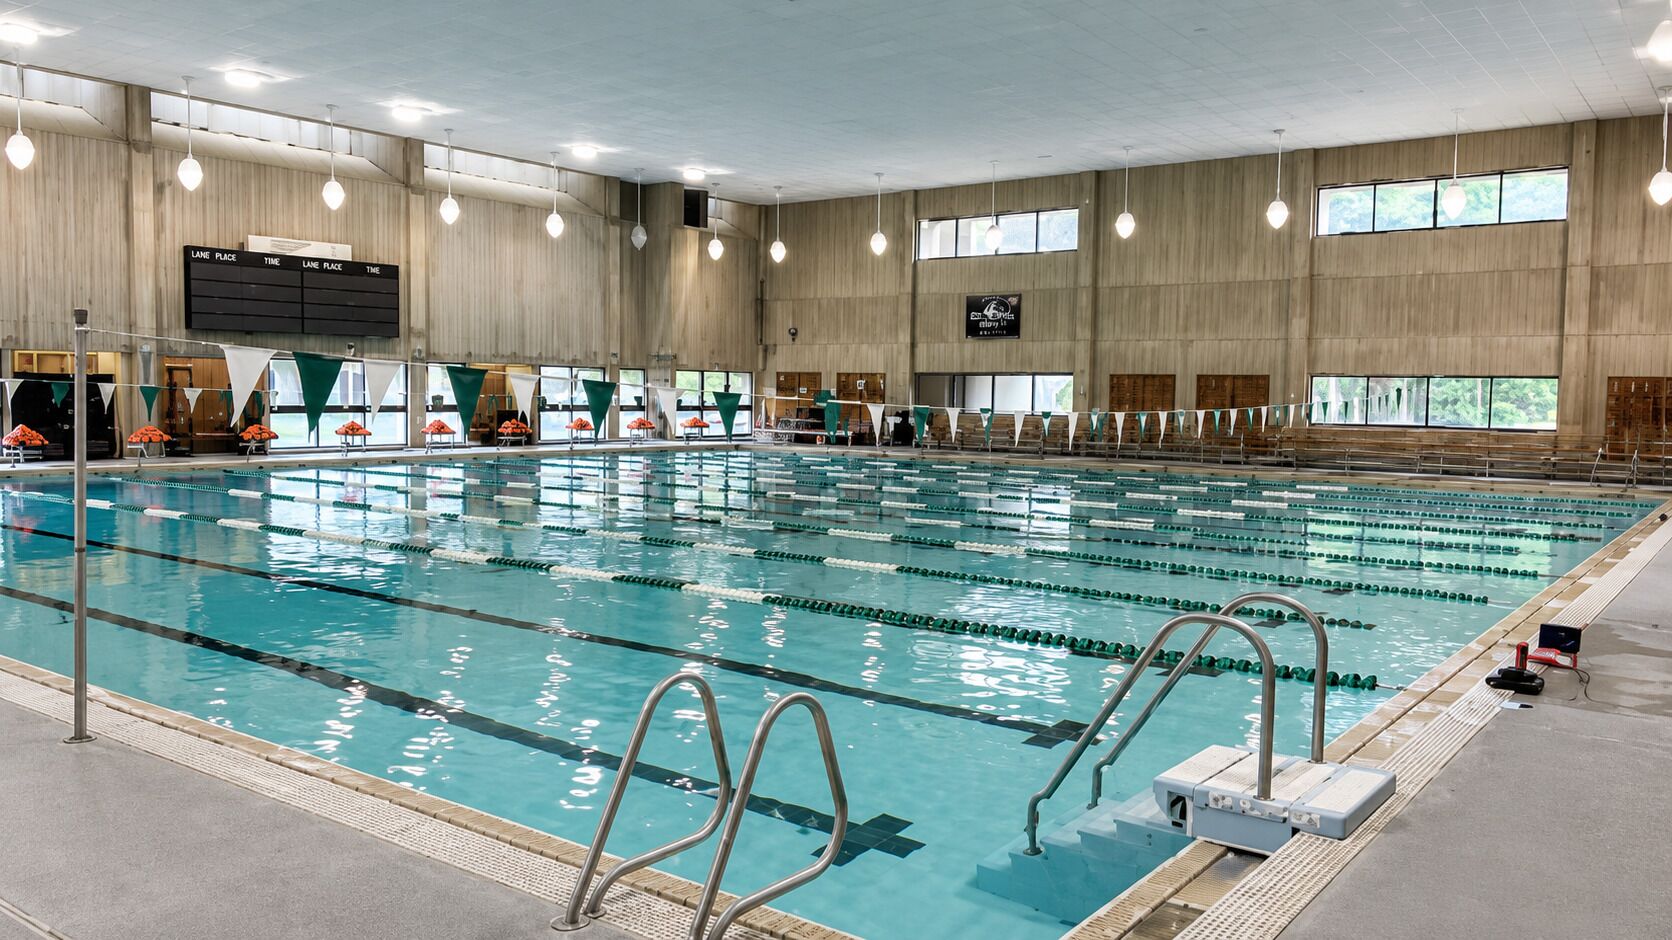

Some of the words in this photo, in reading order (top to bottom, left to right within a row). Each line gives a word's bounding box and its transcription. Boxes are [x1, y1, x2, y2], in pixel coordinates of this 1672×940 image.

[192, 250, 210, 260] LANE
[215, 252, 237, 262] PLACE
[264, 257, 280, 266] TIME
[302, 260, 320, 269] LANE
[323, 262, 343, 271] PLACE
